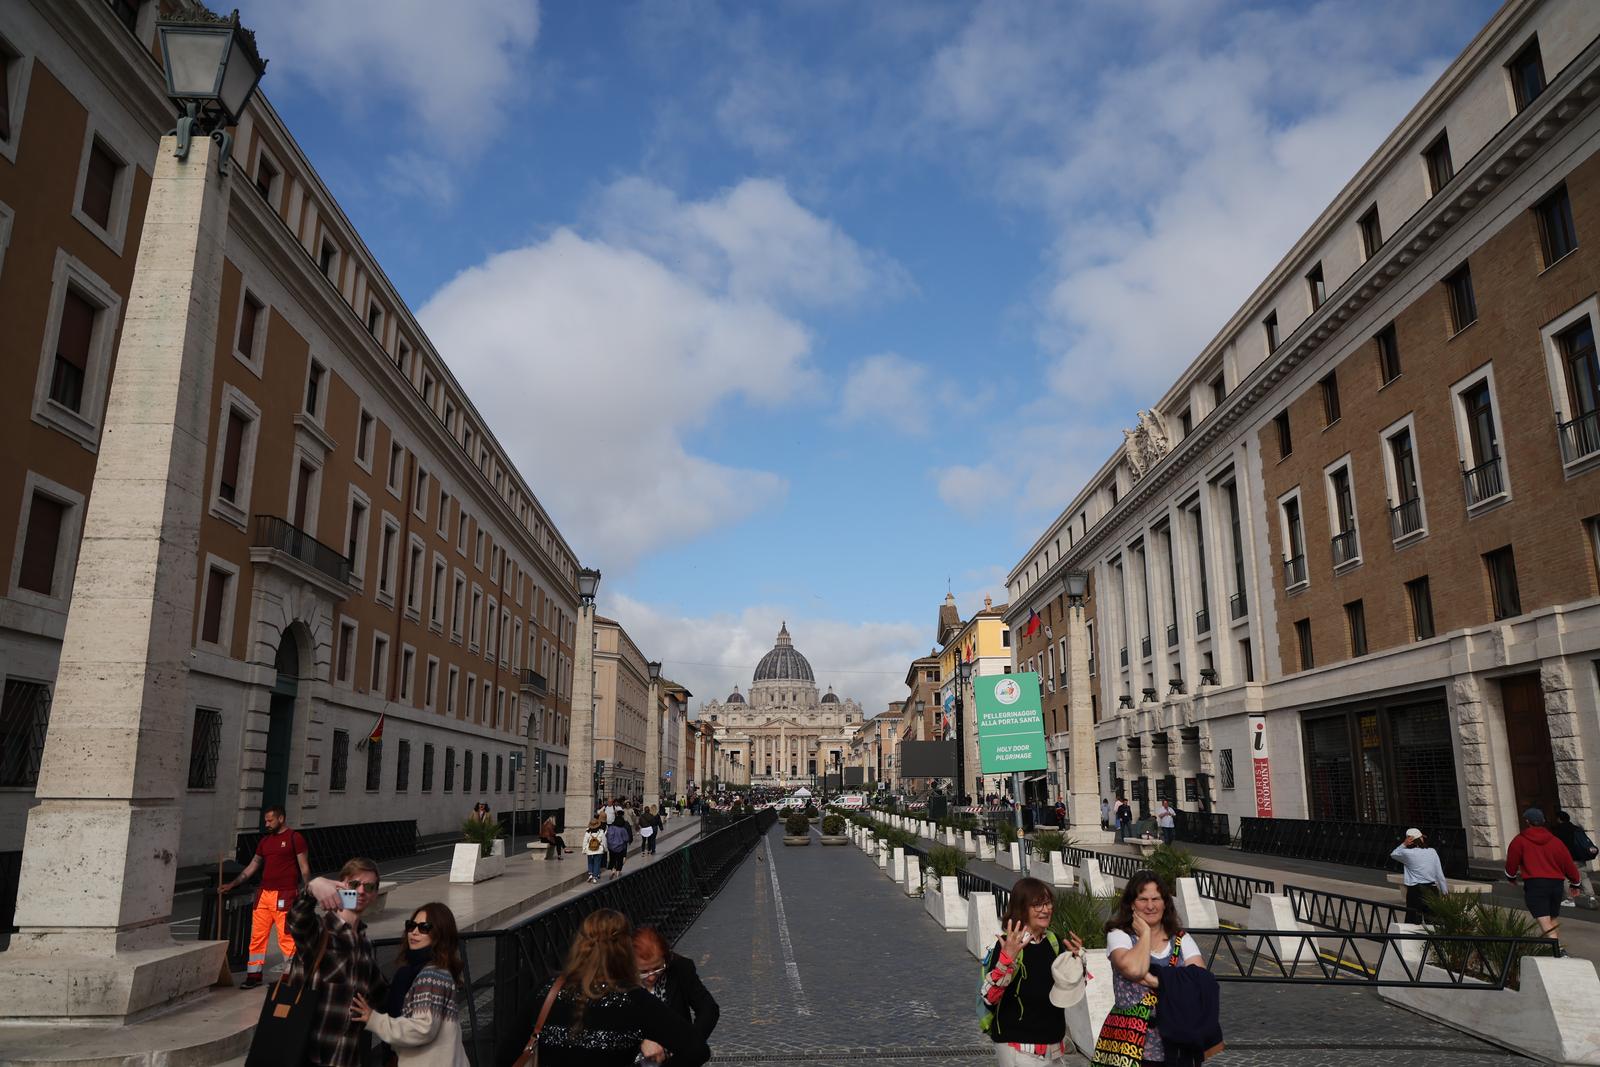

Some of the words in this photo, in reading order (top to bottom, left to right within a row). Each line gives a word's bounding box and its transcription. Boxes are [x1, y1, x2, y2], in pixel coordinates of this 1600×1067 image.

[983, 710, 1037, 720] PELLEGRINAGGIO
[998, 718, 1019, 726] PORTA
[1019, 716, 1041, 724] SANTA
[996, 745, 1013, 753] HOLY
[1013, 744, 1030, 752] DOOR
[995, 752, 1033, 761] PILGRIMAGE
[1255, 762, 1264, 811] TOURIST
[1261, 762, 1271, 811] INFOPOINT
